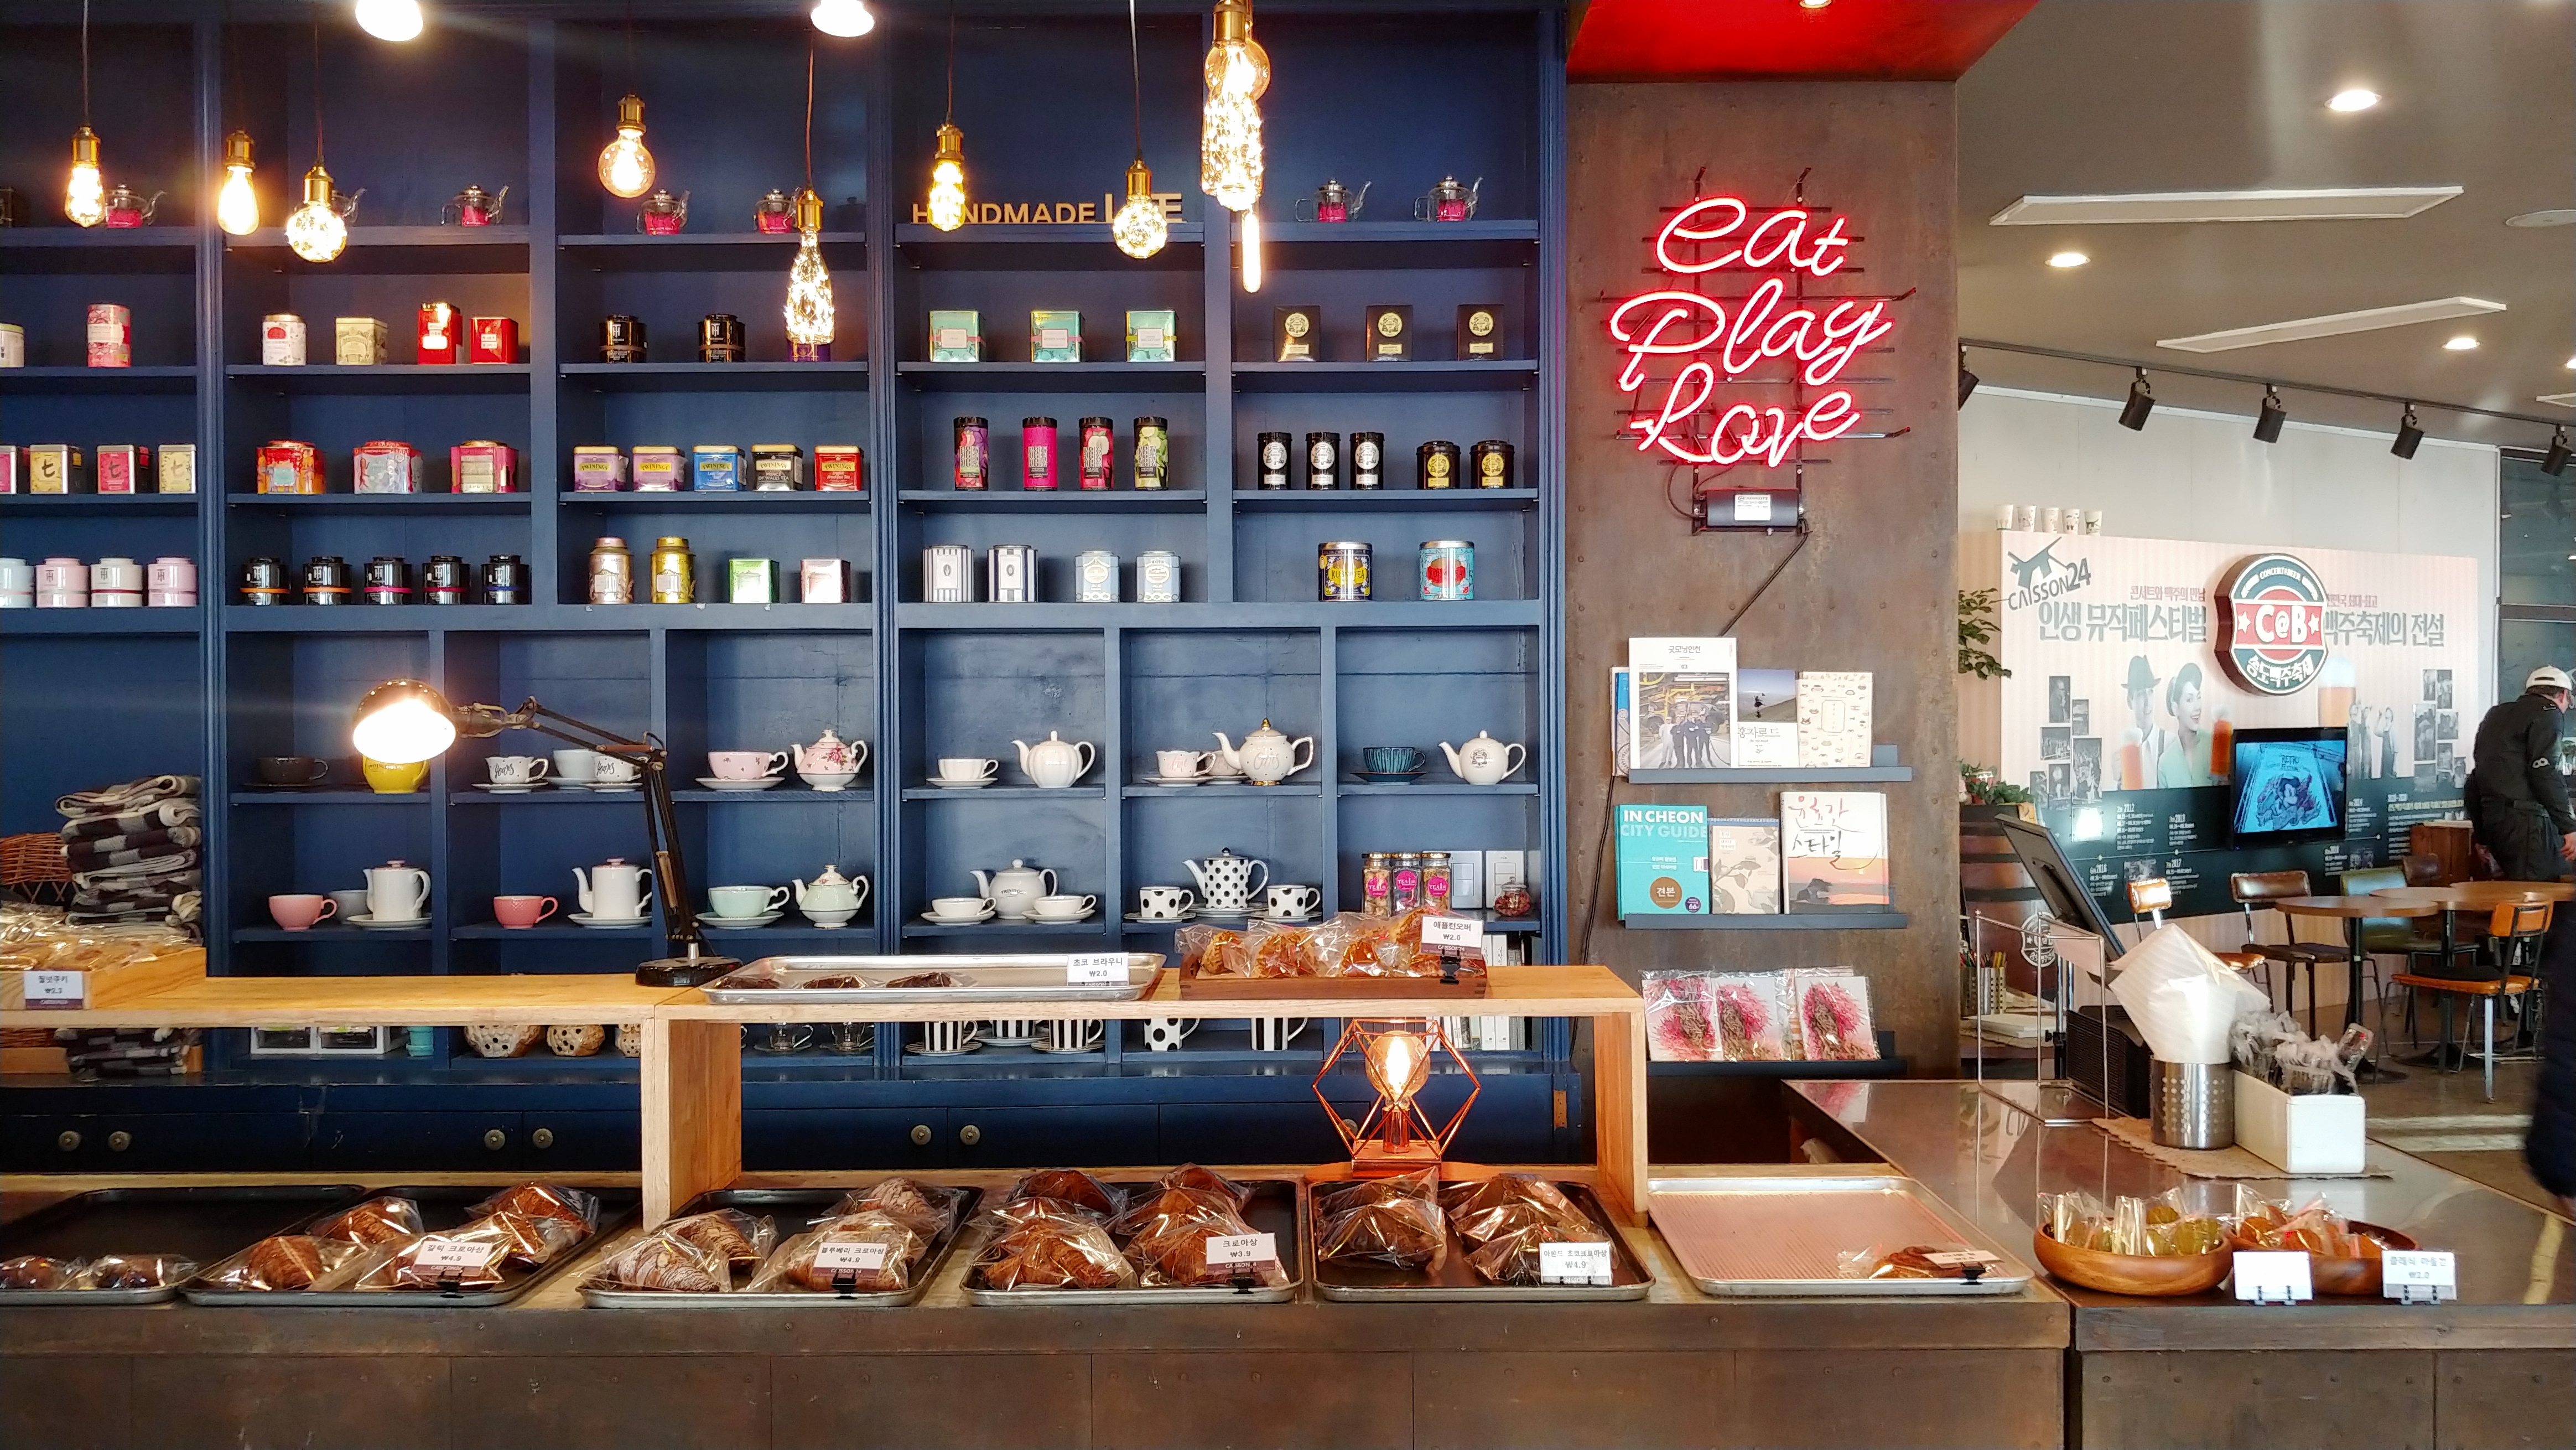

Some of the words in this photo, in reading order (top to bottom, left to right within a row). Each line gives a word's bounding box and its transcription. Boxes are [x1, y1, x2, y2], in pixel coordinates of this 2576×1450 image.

[912, 203, 1096, 223] HNDMADE
[1656, 196, 1848, 277] eat
[1609, 277, 1894, 392] Play
[1629, 360, 1862, 468] Love
[1354, 569, 1364, 579] TEA
[2190, 587, 2206, 602] 만남
[2038, 601, 2082, 642] 인생
[2086, 603, 2207, 644] 뮤직페스티벌
[2255, 604, 2308, 644] C@B
[2411, 612, 2444, 648] 전설
[1668, 645, 1701, 654] 굿모닝인천
[1737, 726, 1781, 738] 홍차로드
[1623, 810, 1643, 822] IN
[1645, 810, 1704, 824] CHEON
[1620, 824, 1654, 837] CITY
[1657, 825, 1707, 838] GUIDE
[1788, 830, 1880, 870] 스타일
[1656, 887, 1676, 897] 견본
[1092, 957, 1123, 966] 브라우니
[1222, 1239, 1258, 1247] 크로아상
